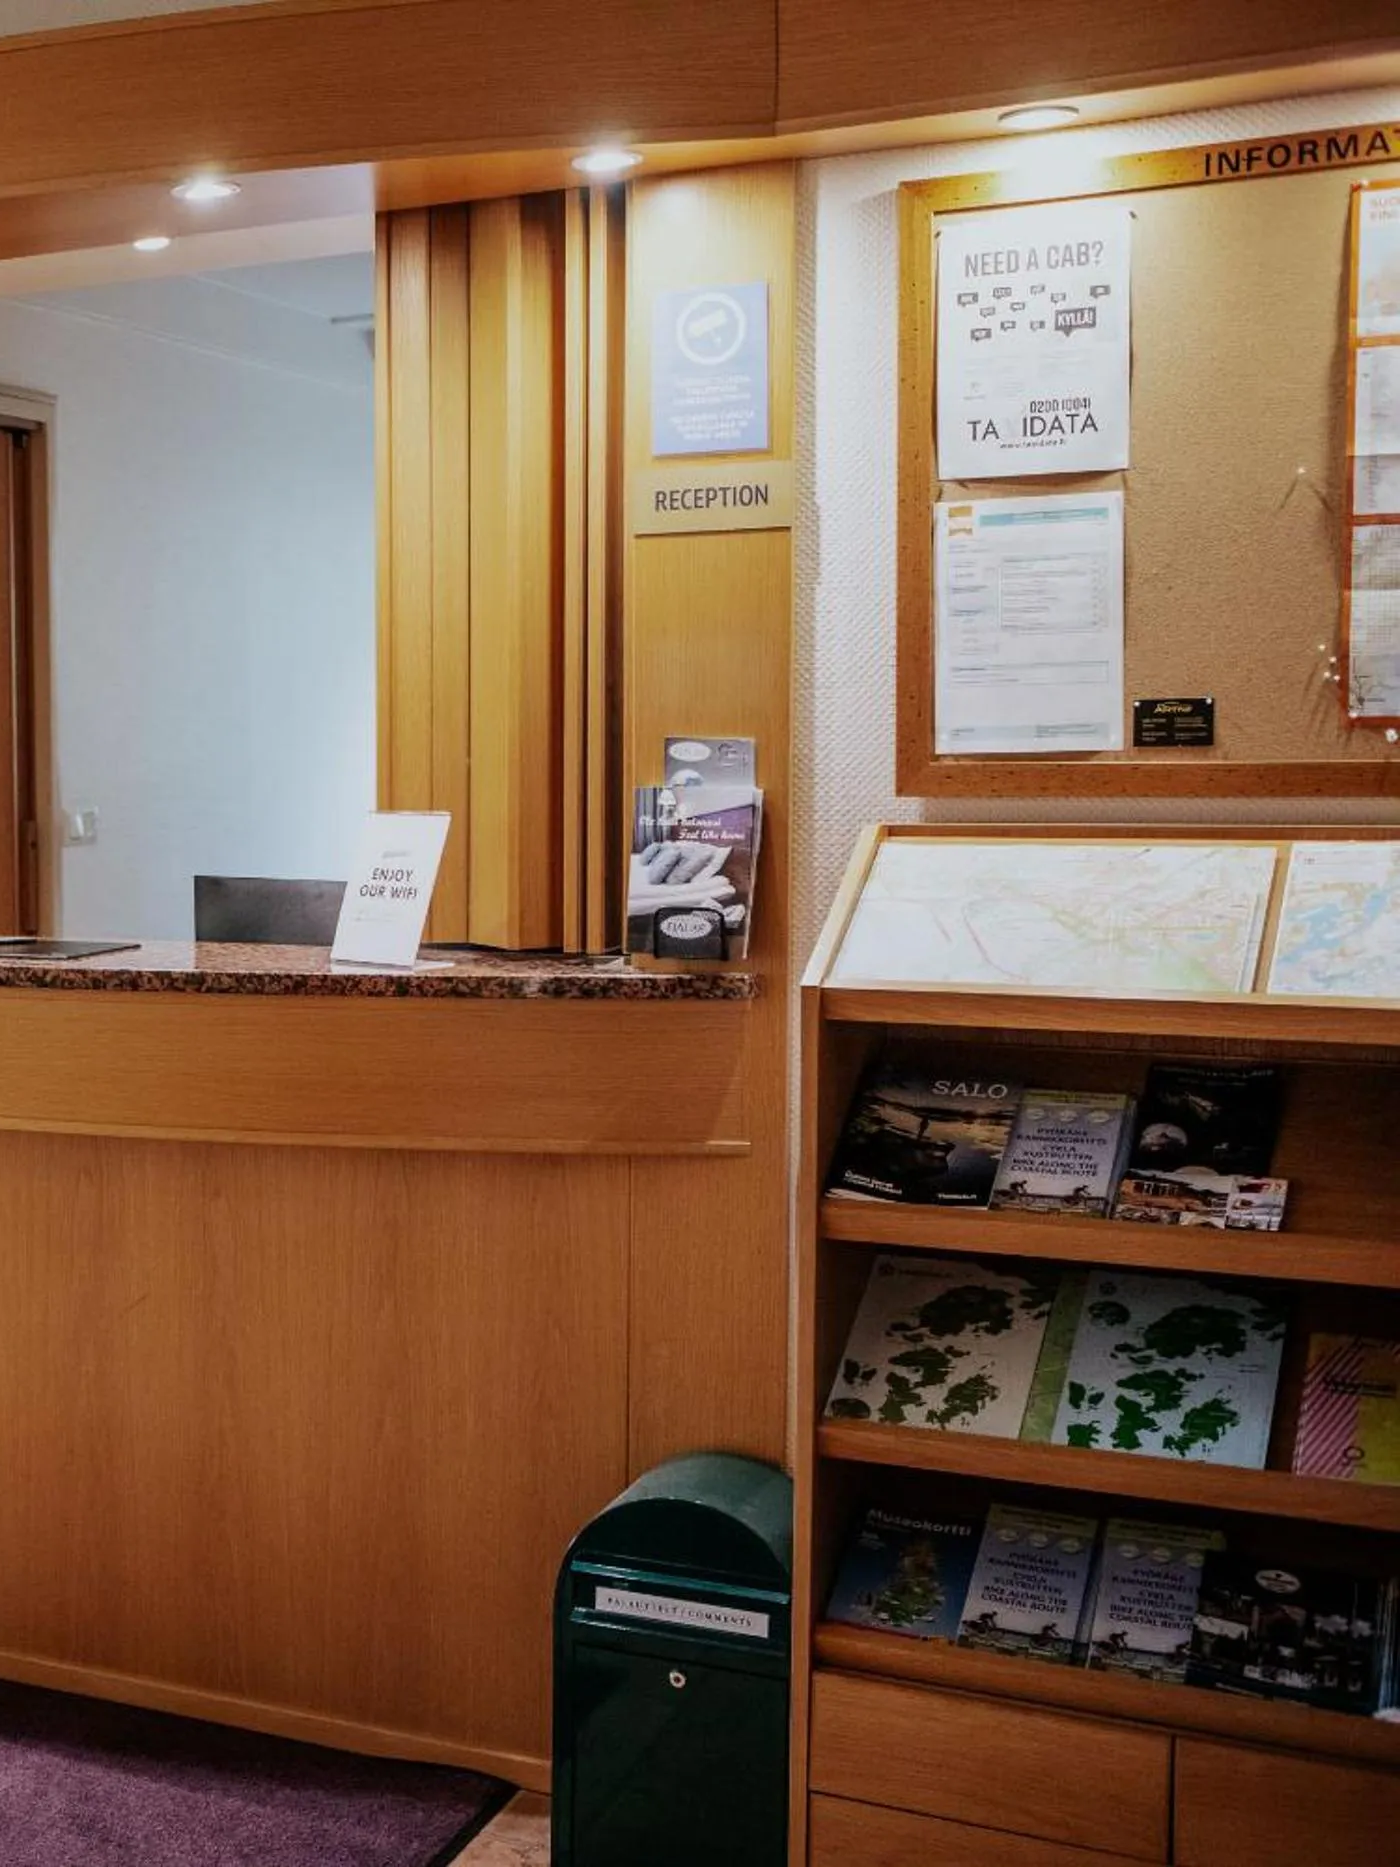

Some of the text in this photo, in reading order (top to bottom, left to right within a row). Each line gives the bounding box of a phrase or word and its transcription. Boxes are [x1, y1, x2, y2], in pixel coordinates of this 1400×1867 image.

[1205, 128, 1400, 177] INFORMA
[965, 240, 1105, 277] NEED A CAB?
[967, 413, 1098, 441] TAIDATA
[654, 484, 769, 512] RECEPTION
[371, 867, 414, 882] ENJOY
[359, 884, 418, 900] OUR WIFI
[932, 1080, 1008, 1099] SALO
[867, 1508, 972, 1537] Museokortti
